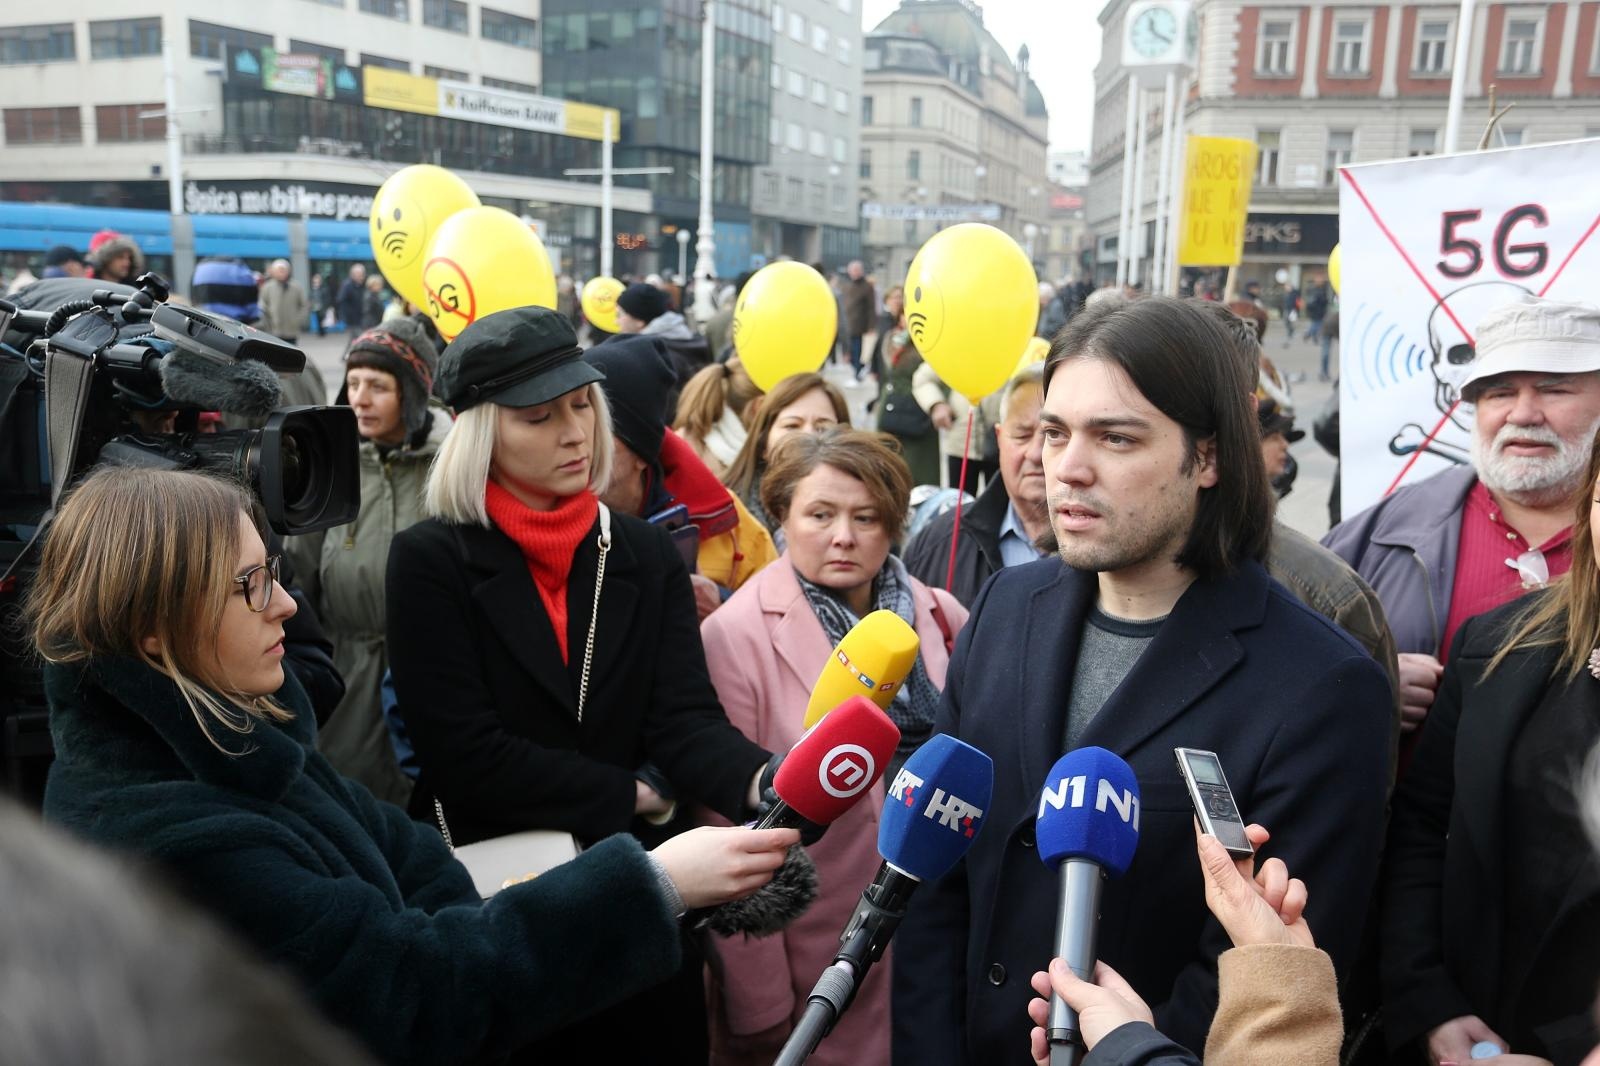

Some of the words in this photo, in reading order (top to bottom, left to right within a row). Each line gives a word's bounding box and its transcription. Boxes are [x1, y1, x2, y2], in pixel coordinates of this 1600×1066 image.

[1437, 203, 1549, 279] 5G
[924, 788, 984, 838] HRT
[1038, 775, 1087, 819] N1
[1095, 778, 1140, 832] N1
